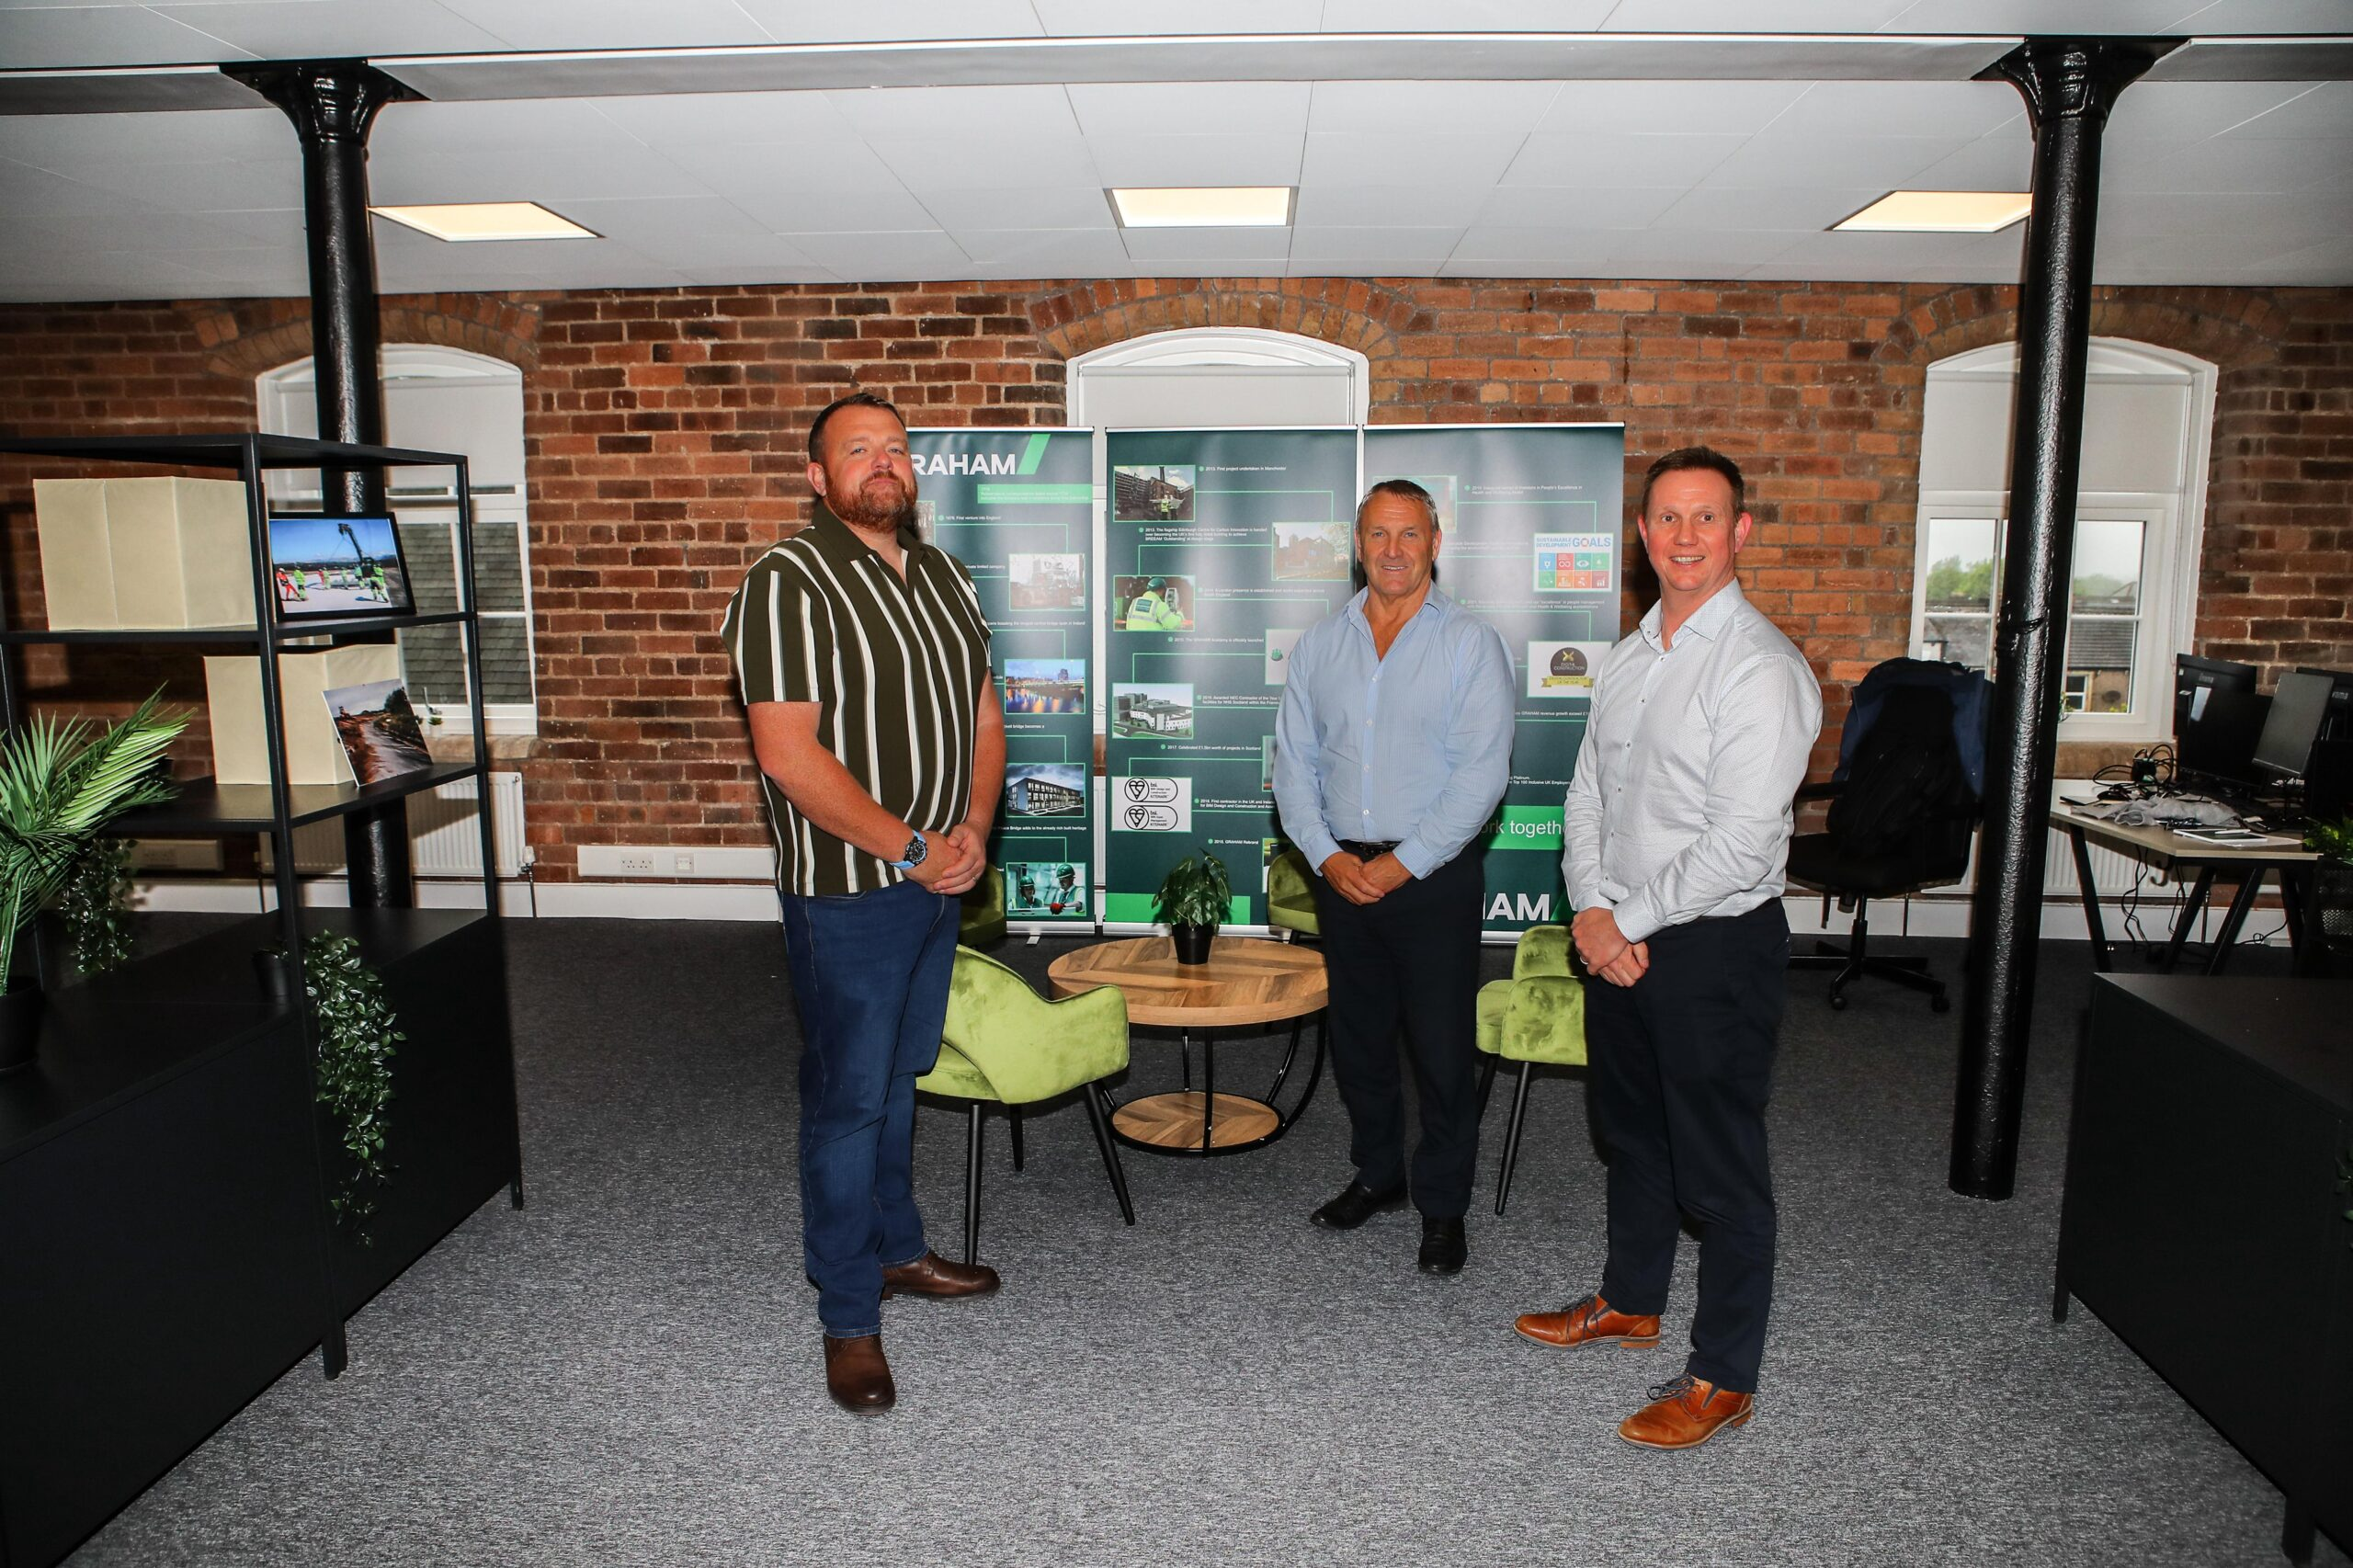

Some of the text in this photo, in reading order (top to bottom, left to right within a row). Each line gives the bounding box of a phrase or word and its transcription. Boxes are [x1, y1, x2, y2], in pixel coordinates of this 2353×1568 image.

[910, 453, 1016, 475] RAHAM
[1572, 537, 1611, 547] GOALS
[1481, 820, 1563, 838] ork togeth
